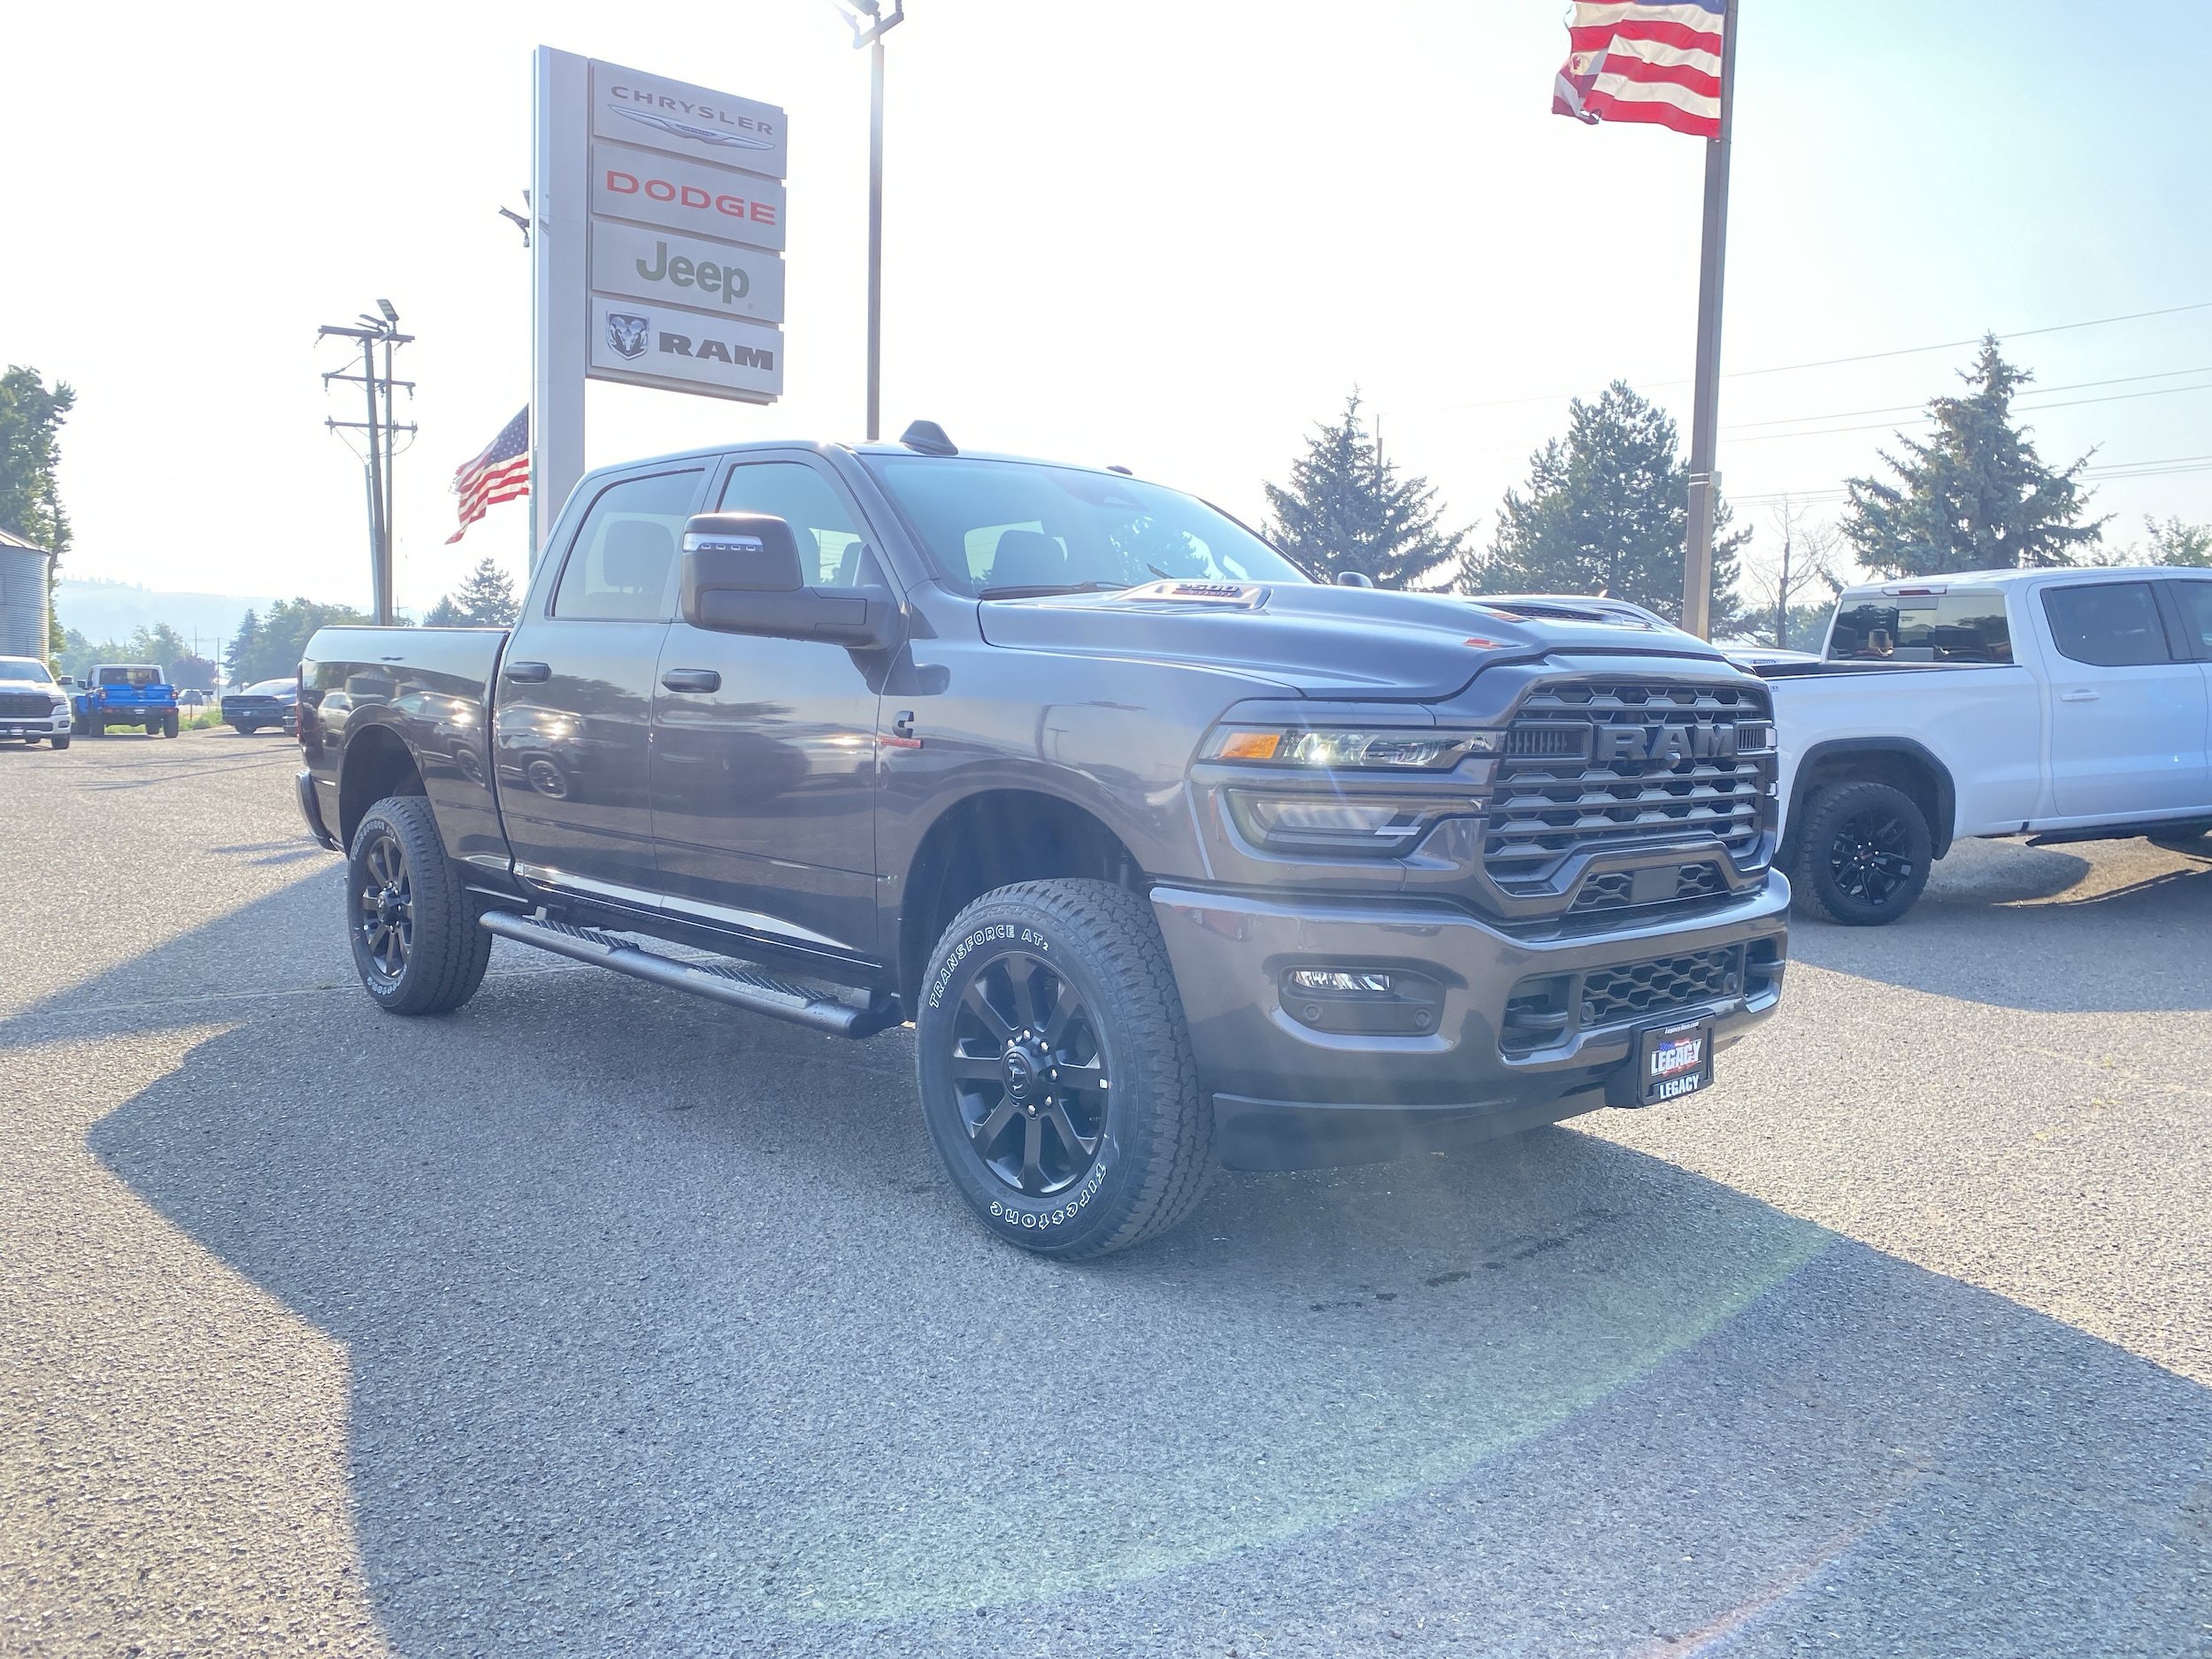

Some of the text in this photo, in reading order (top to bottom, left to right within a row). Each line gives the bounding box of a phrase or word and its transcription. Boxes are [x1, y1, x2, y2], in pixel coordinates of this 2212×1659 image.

[611, 86, 773, 135] CHRYSLER
[606, 170, 776, 226] DODGE
[635, 241, 749, 304] Jeep
[658, 331, 773, 371] RAM
[1597, 723, 1735, 762] RAM
[929, 925, 1015, 1009] TRANSFORCE
[1651, 1041, 1701, 1075] LEGACY
[1660, 1074, 1699, 1100] LEGACY
[990, 1163, 1106, 1230] Firestone
